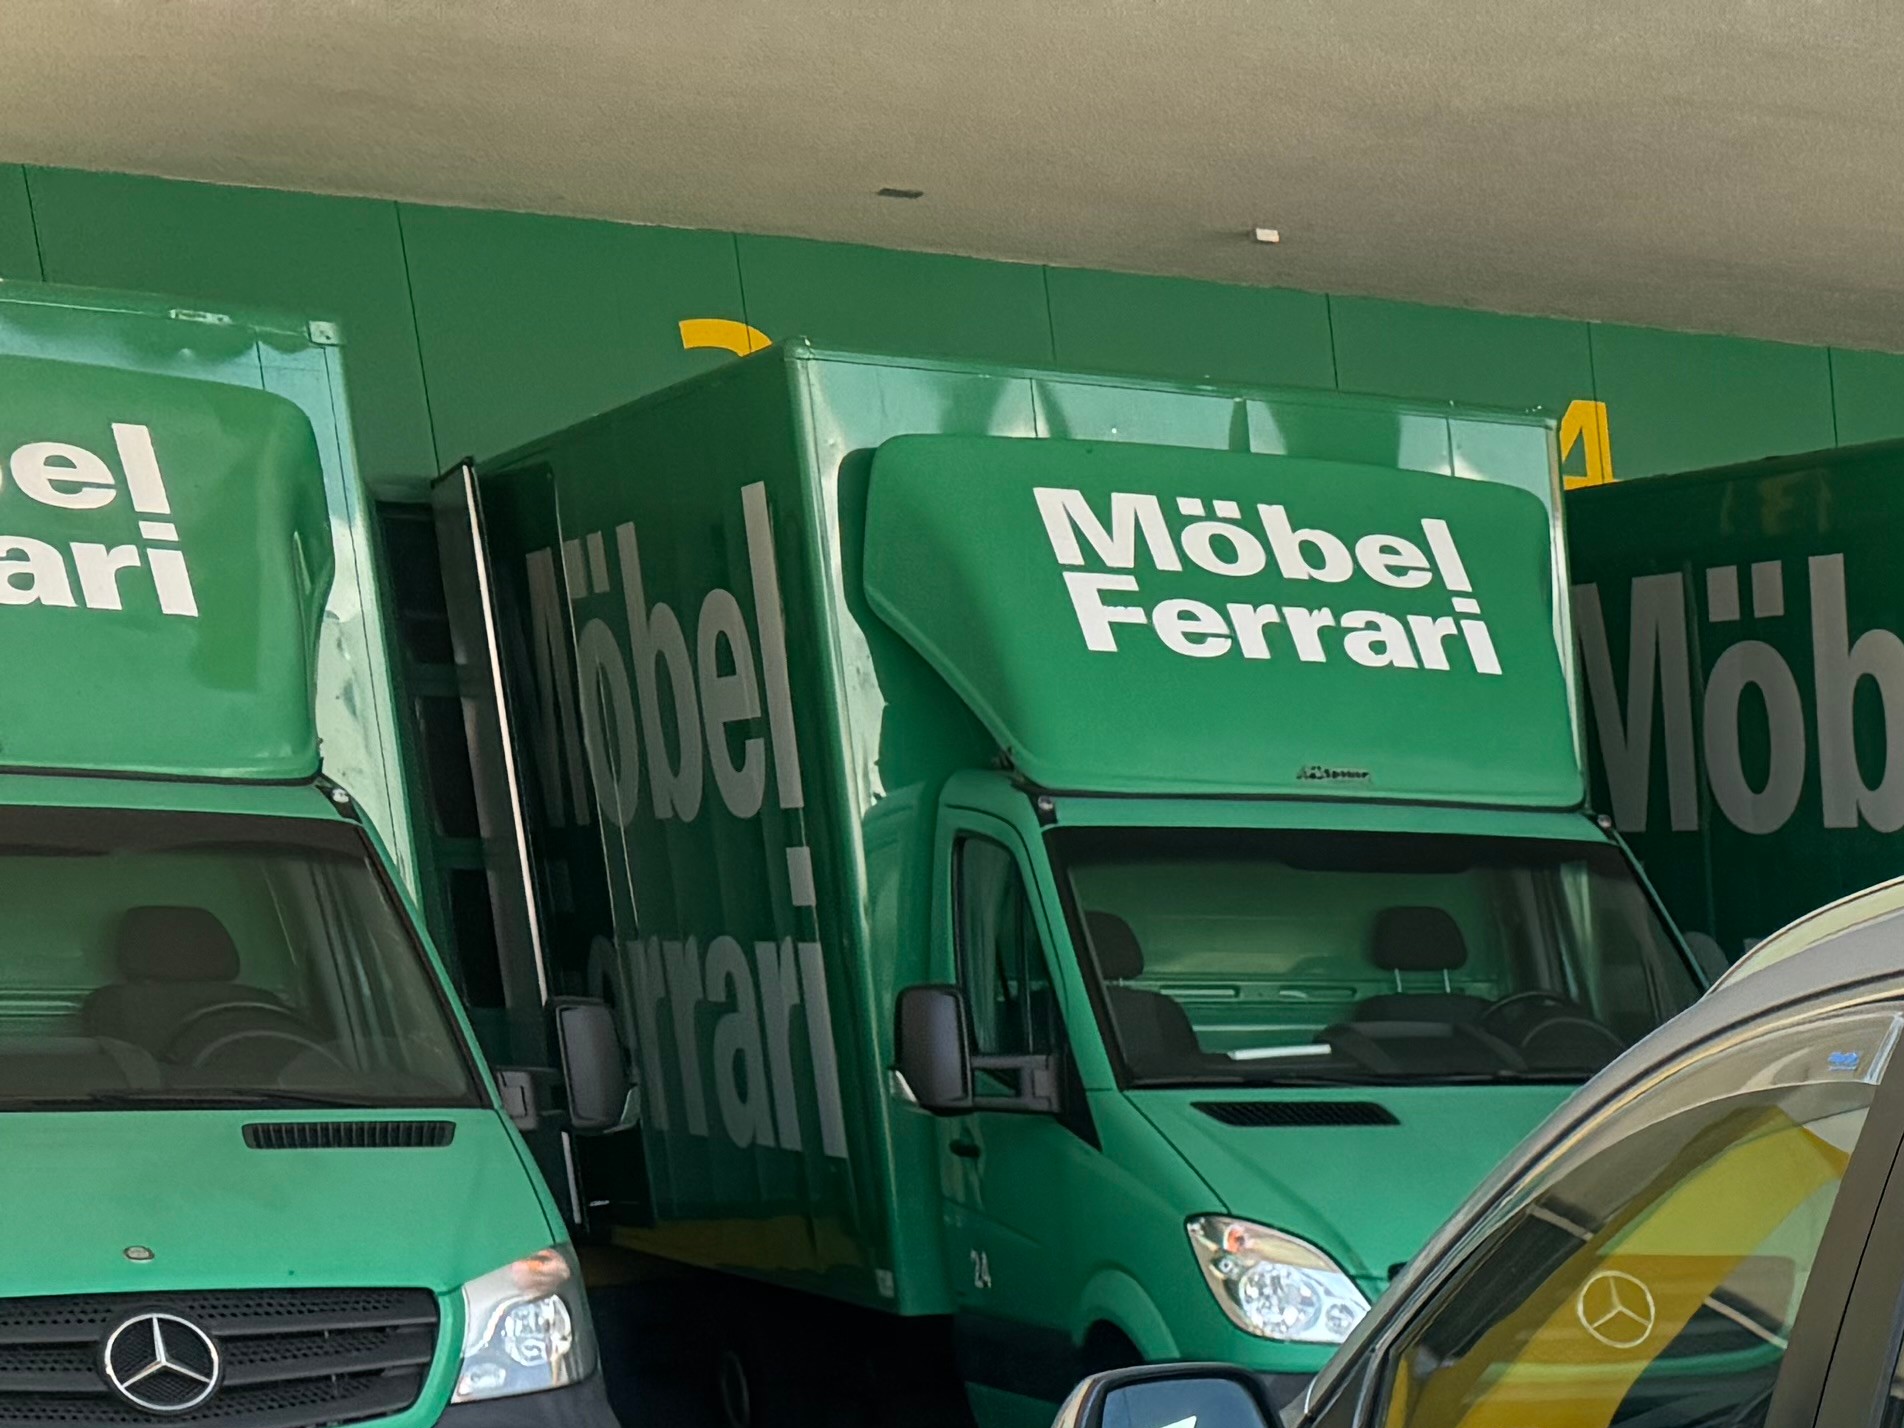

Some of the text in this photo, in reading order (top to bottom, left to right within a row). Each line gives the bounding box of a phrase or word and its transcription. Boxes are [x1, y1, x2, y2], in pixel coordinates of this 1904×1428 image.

[0, 423, 171, 514] el
[1033, 487, 1473, 593] Möbel
[1062, 572, 1503, 675] Ferrari
